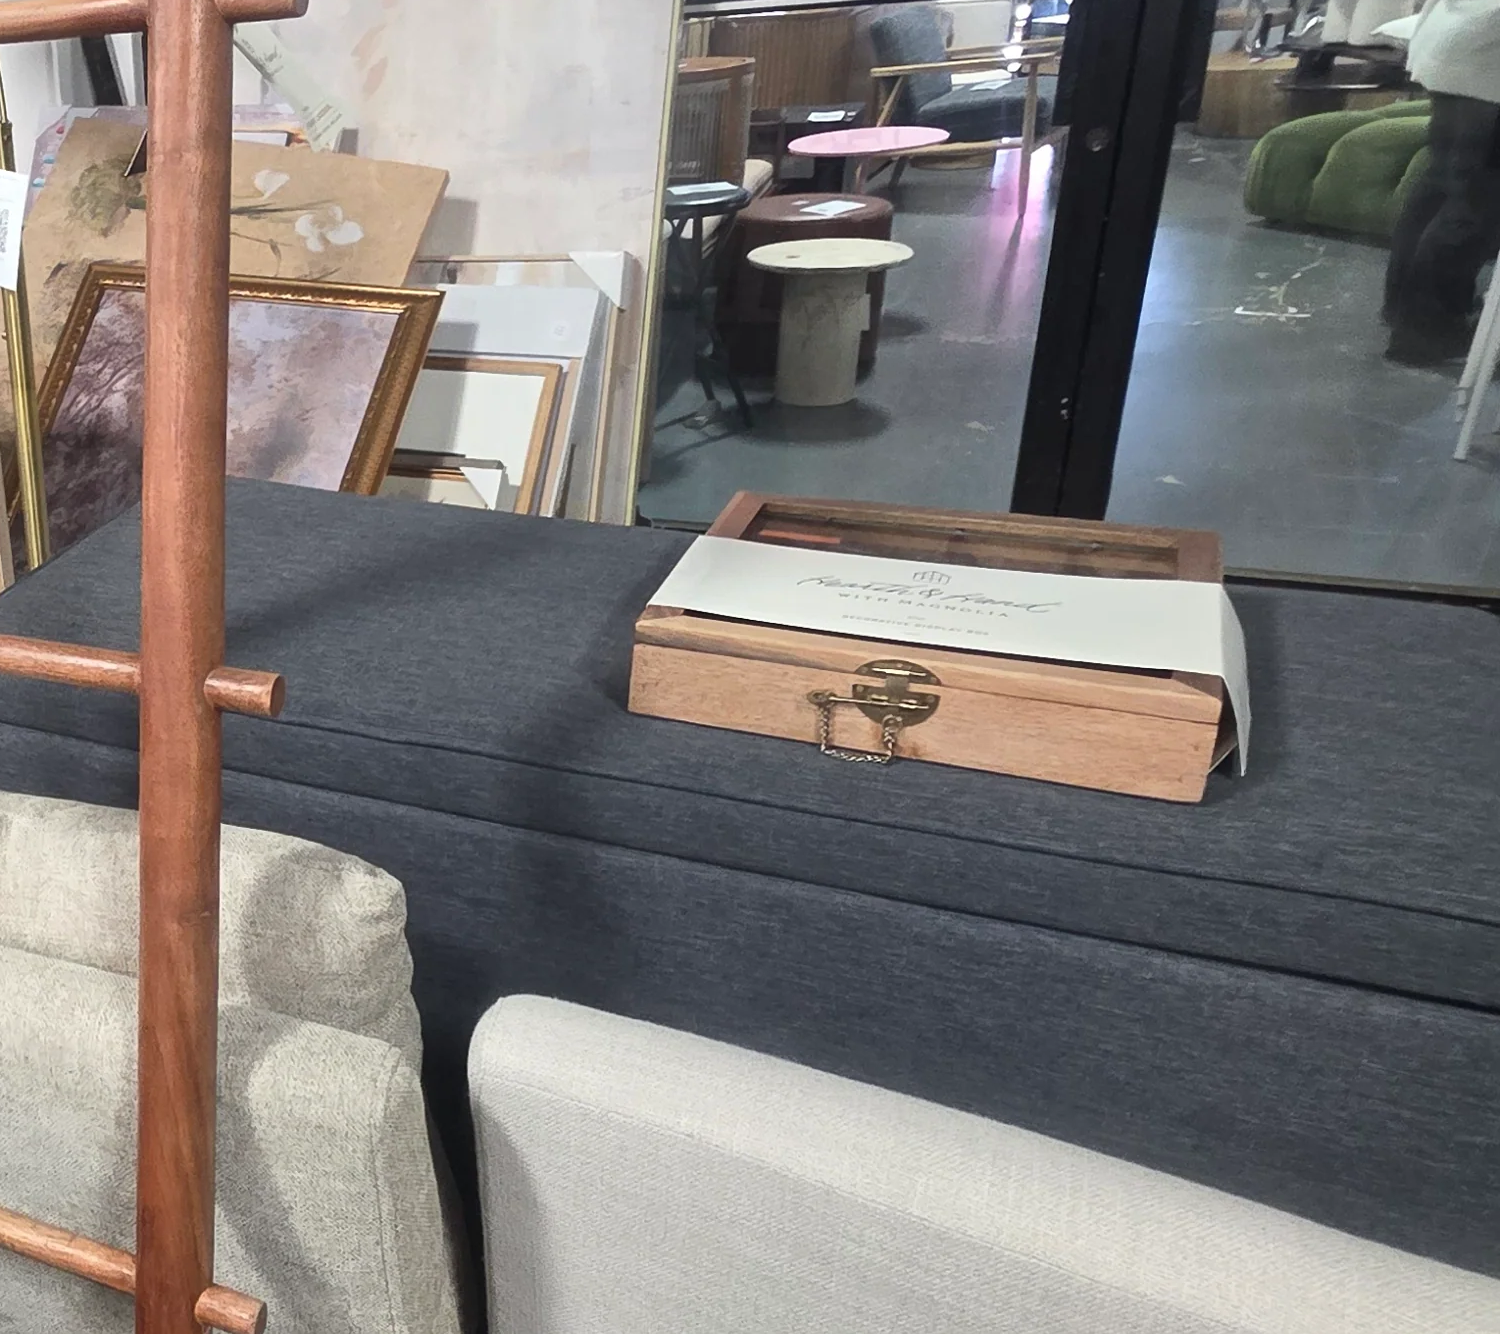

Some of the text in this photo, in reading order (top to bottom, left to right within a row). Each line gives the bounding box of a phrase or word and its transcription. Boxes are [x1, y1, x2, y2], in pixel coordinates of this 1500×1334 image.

[837, 592, 889, 603] WITH
[898, 600, 1009, 618] MAGNOLIA
[940, 592, 1062, 614] Hand
